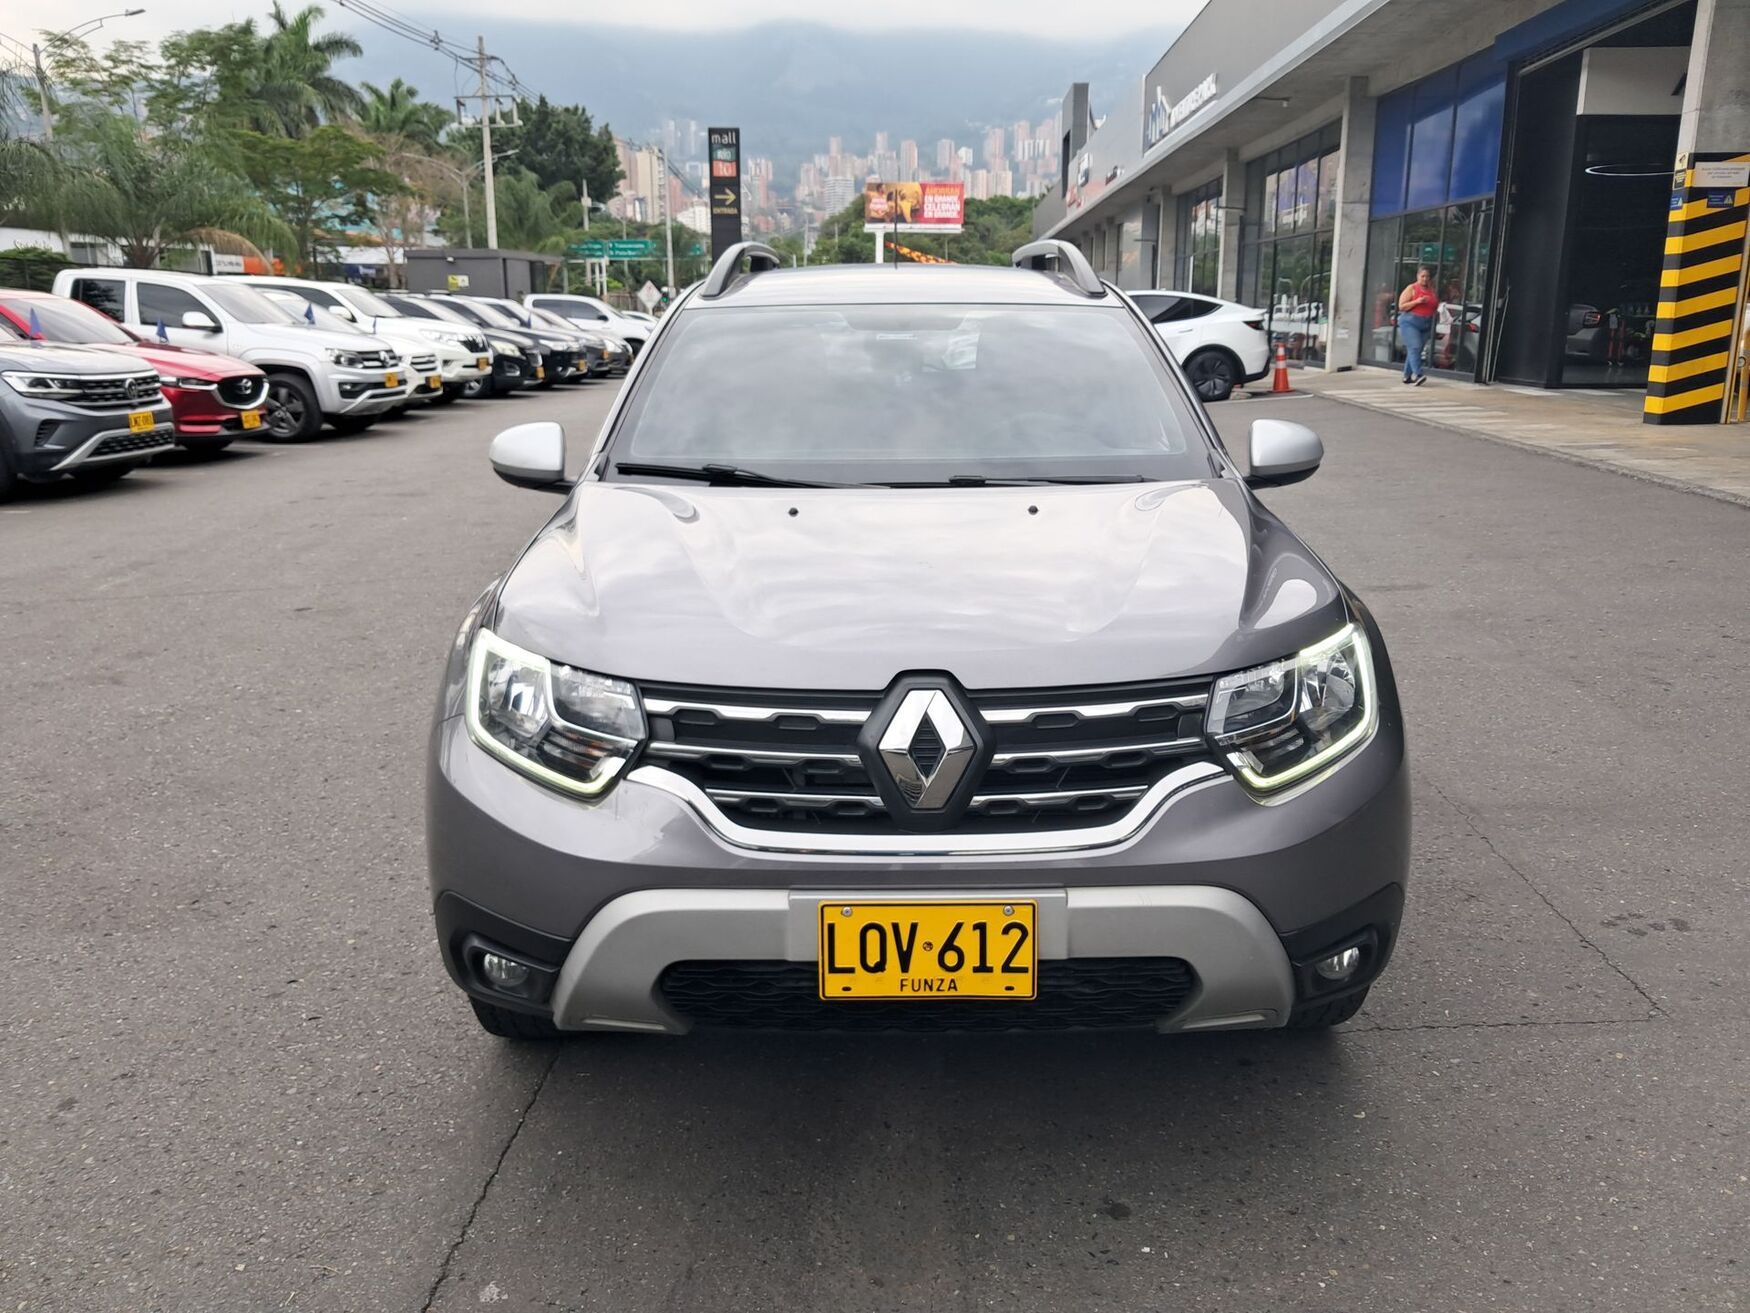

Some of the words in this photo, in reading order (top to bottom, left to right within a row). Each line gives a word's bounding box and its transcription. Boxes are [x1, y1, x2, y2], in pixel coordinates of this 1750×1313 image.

[711, 132, 736, 144] mall
[827, 922, 919, 974] LQV
[937, 921, 1029, 973] 612
[900, 978, 958, 992] FUNZA
